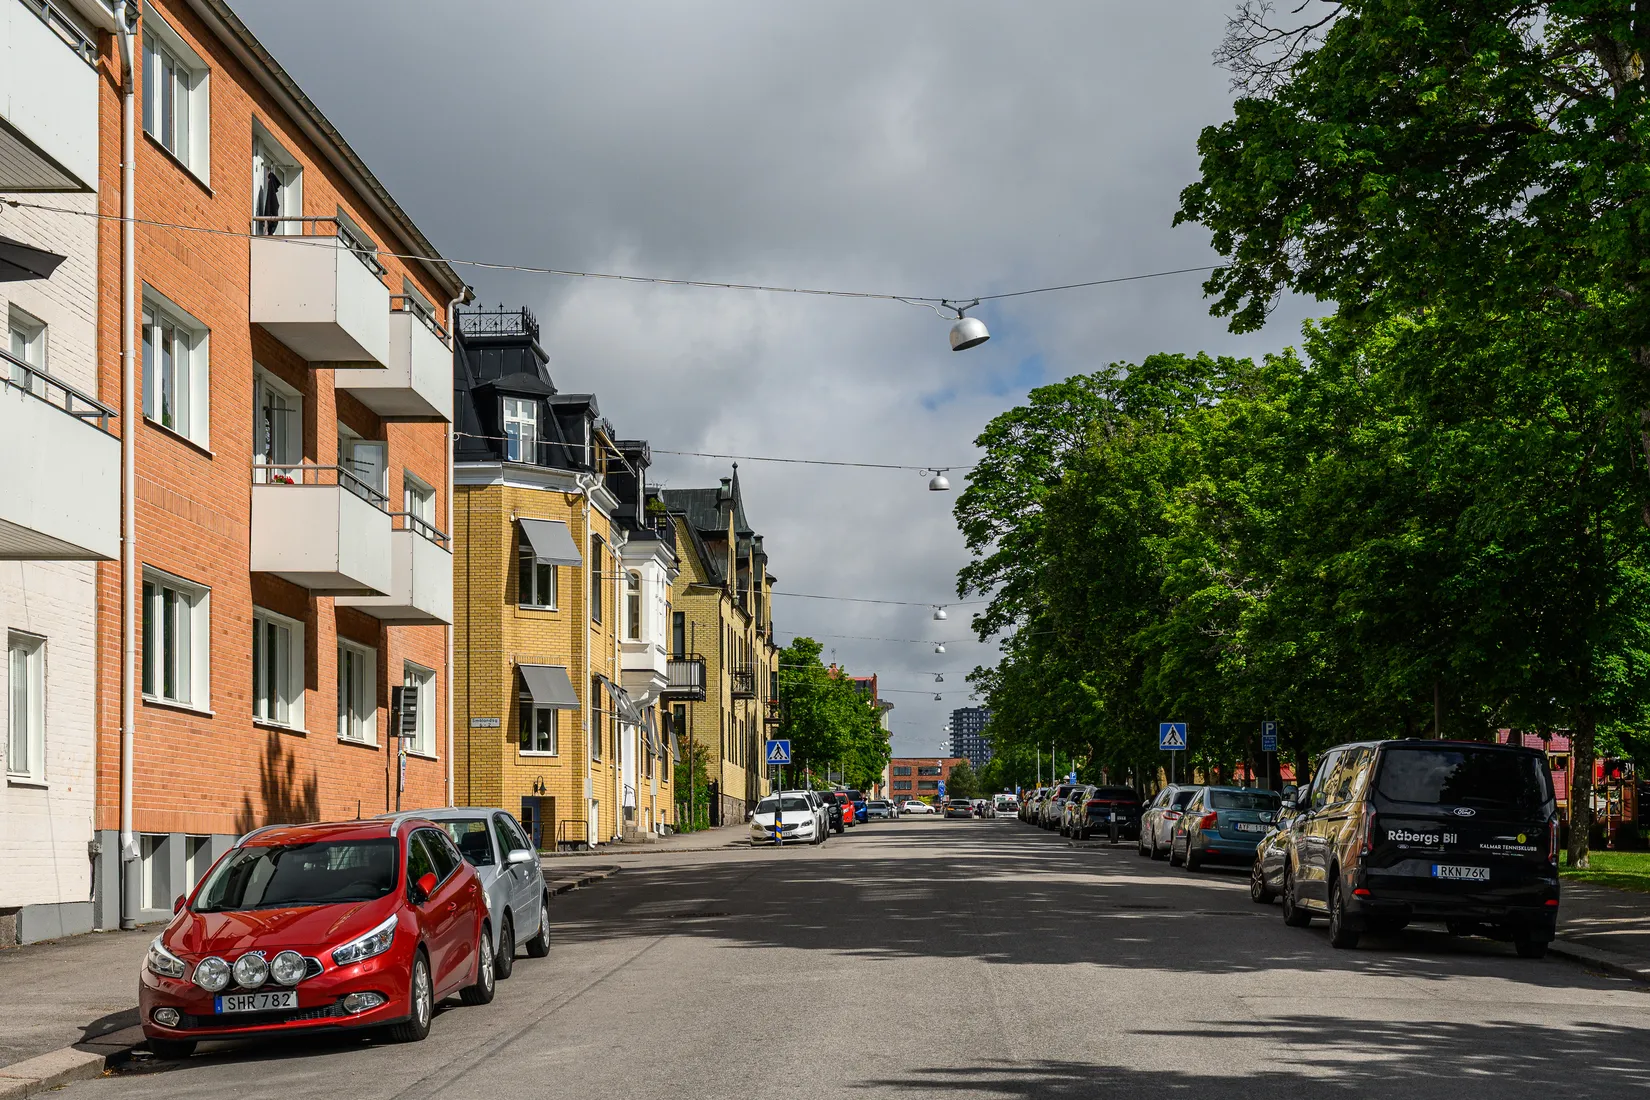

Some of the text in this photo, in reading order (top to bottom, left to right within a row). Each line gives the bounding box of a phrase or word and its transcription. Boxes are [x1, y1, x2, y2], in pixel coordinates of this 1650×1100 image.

[1266, 723, 1274, 734] P
[1388, 829, 1457, 845] Råbergs Bil
[1502, 844, 1537, 852] TENNISKLUBB
[1441, 866, 1485, 878] RKN 76K
[228, 996, 256, 1010] SHR
[261, 993, 291, 1008] 782
